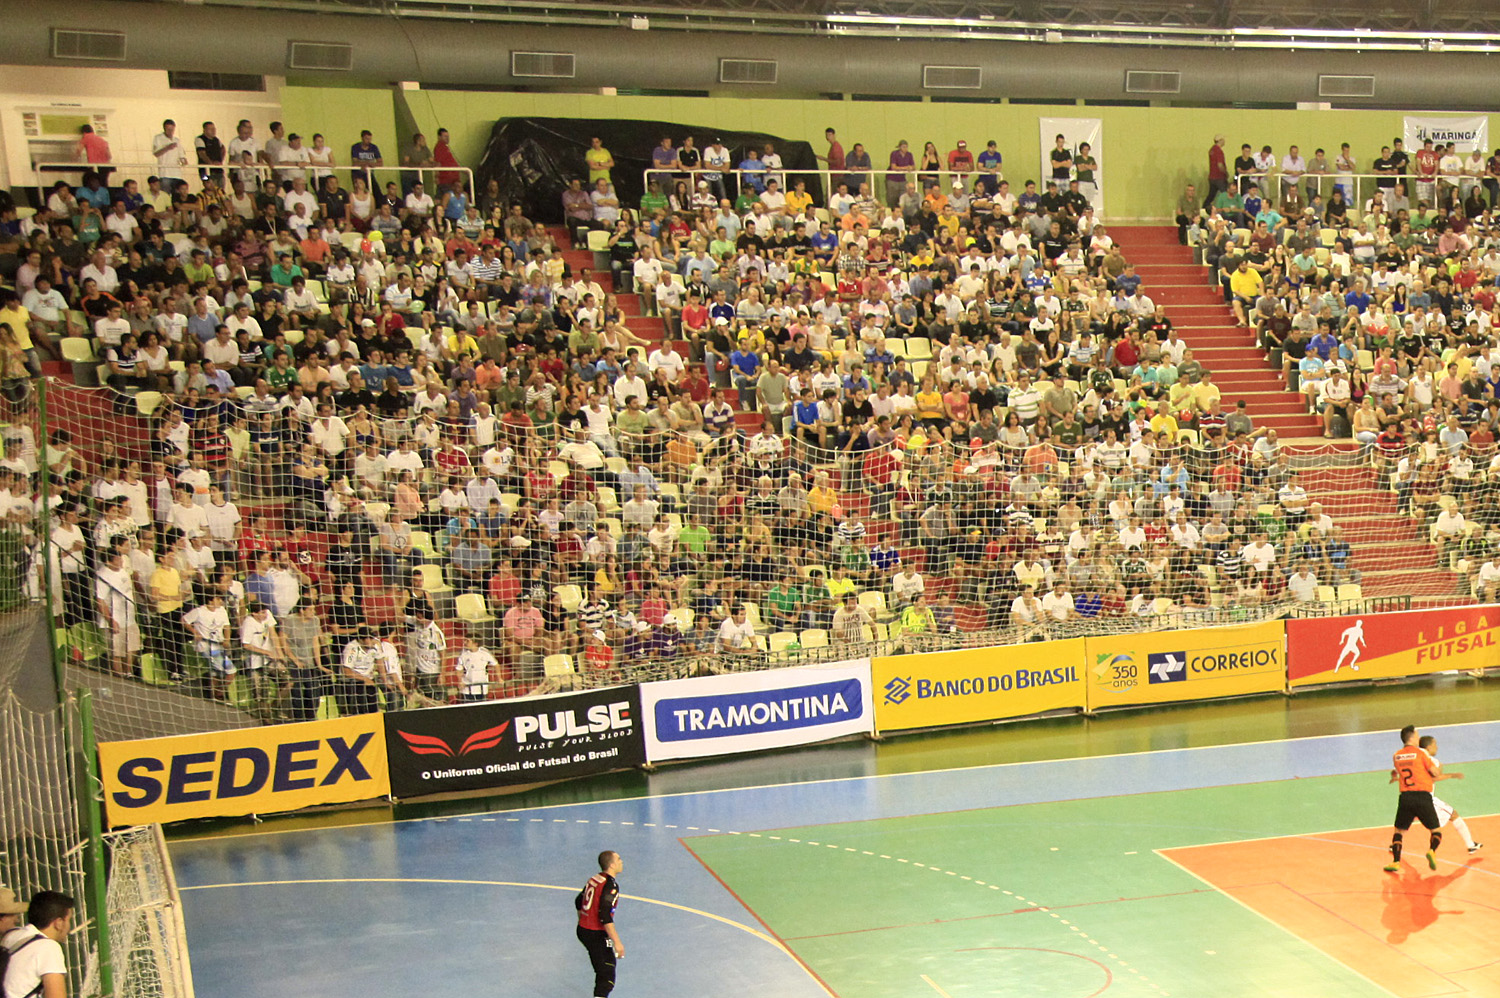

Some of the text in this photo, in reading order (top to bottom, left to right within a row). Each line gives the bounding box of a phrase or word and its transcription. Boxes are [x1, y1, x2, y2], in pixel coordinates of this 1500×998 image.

[1418, 615, 1488, 644] LIGA
[1191, 648, 1277, 672] CORREIOS
[1416, 632, 1496, 664] FUTSAL
[917, 666, 1079, 699] BANCO DO BRASIL
[1113, 665, 1137, 679] 350
[1113, 679, 1138, 688] anos
[515, 701, 633, 743] PULSE
[673, 692, 849, 732] TRAMONTINA
[519, 741, 554, 752] PULSE
[112, 731, 375, 809] SEDEX
[422, 748, 618, 780] O Uniforme Oficial do Futsal do Brasil
[1402, 768, 1415, 786] 2
